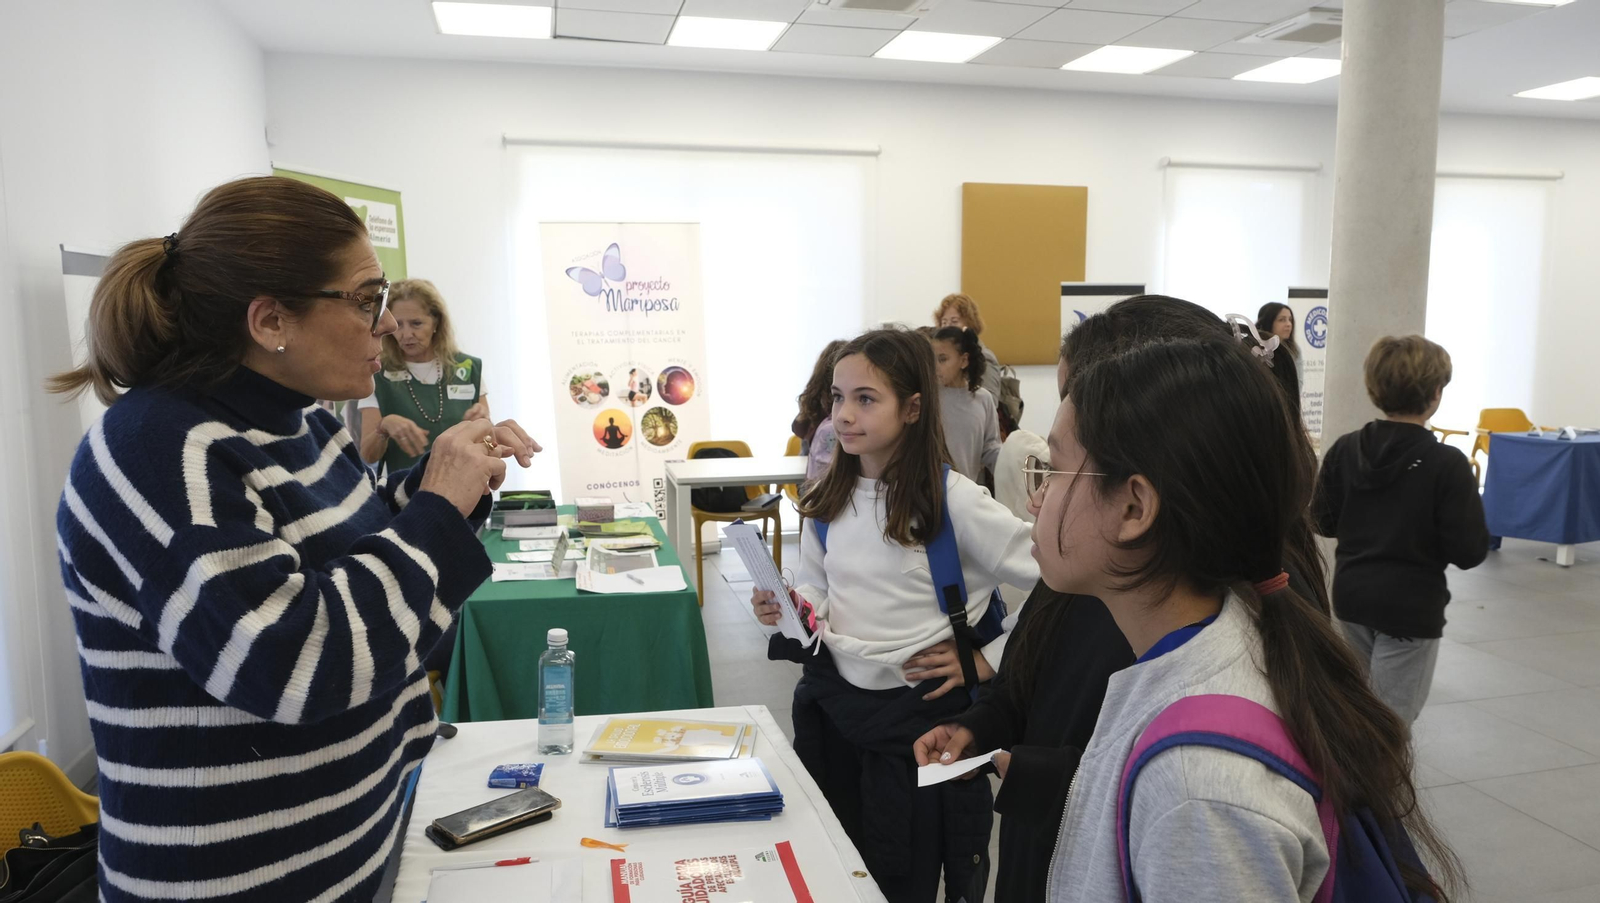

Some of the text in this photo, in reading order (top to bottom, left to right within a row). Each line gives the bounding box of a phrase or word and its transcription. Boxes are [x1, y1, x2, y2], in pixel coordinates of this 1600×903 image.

[625, 276, 671, 296] proyecto
[598, 288, 680, 318] Mariposa
[571, 330, 605, 338] TERAPIAS
[607, 329, 675, 337] COMPLEMENTARIAS
[587, 337, 636, 345] TRATAMIENTO
[586, 480, 641, 491] CONÓCENOS
[640, 771, 655, 797] Esclerosis
[653, 771, 669, 794] Múltiple
[620, 863, 629, 885] MANUAL
[674, 858, 696, 903] GUÍA PARA
[707, 885, 718, 893] DE
